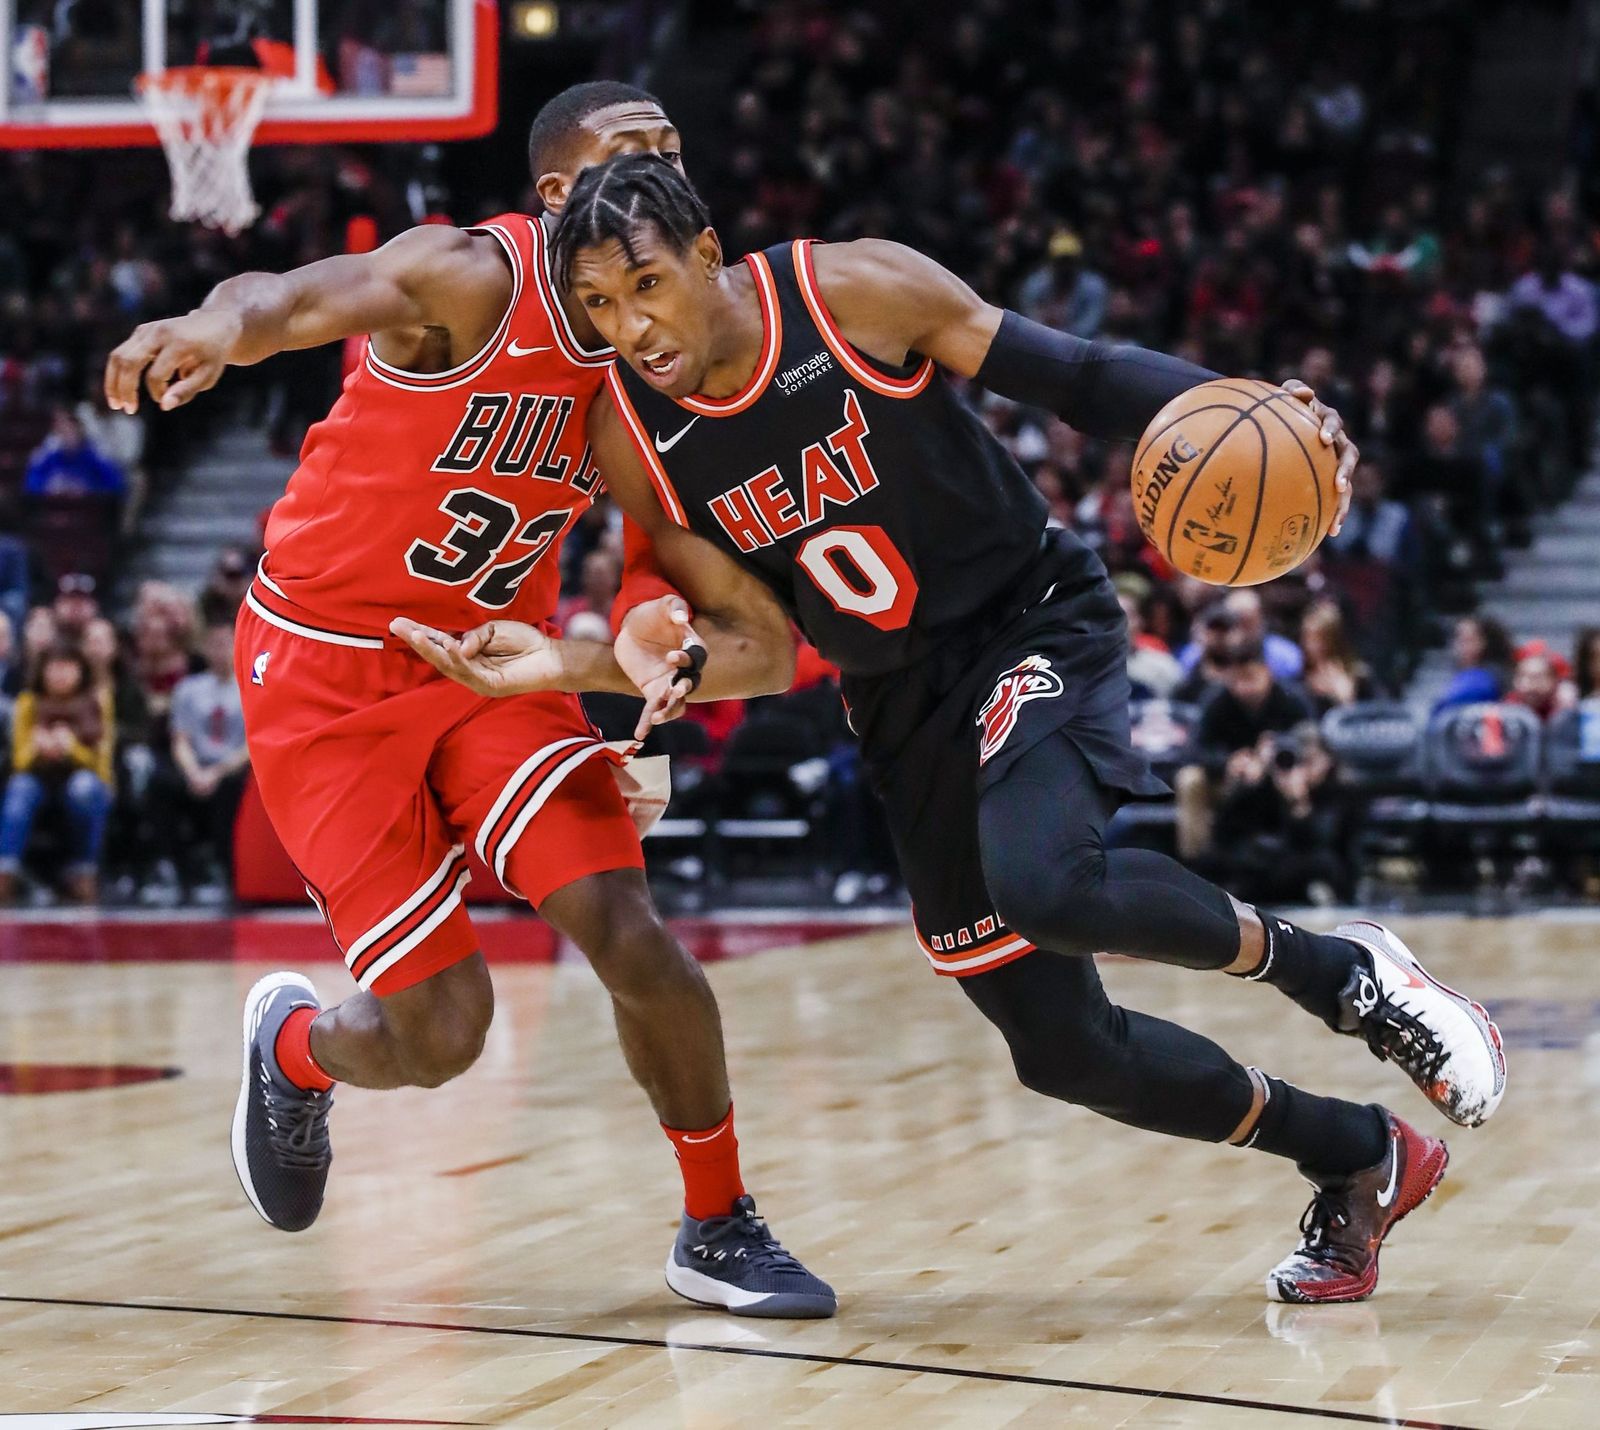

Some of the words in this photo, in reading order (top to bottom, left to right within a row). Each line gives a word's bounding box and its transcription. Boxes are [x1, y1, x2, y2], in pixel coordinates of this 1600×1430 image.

[774, 351, 830, 389] Ultimate
[784, 361, 833, 396] SOFTWARE
[430, 391, 605, 505] BULL
[706, 388, 880, 553] HEAT
[404, 486, 573, 610] 32
[795, 524, 919, 632] 0
